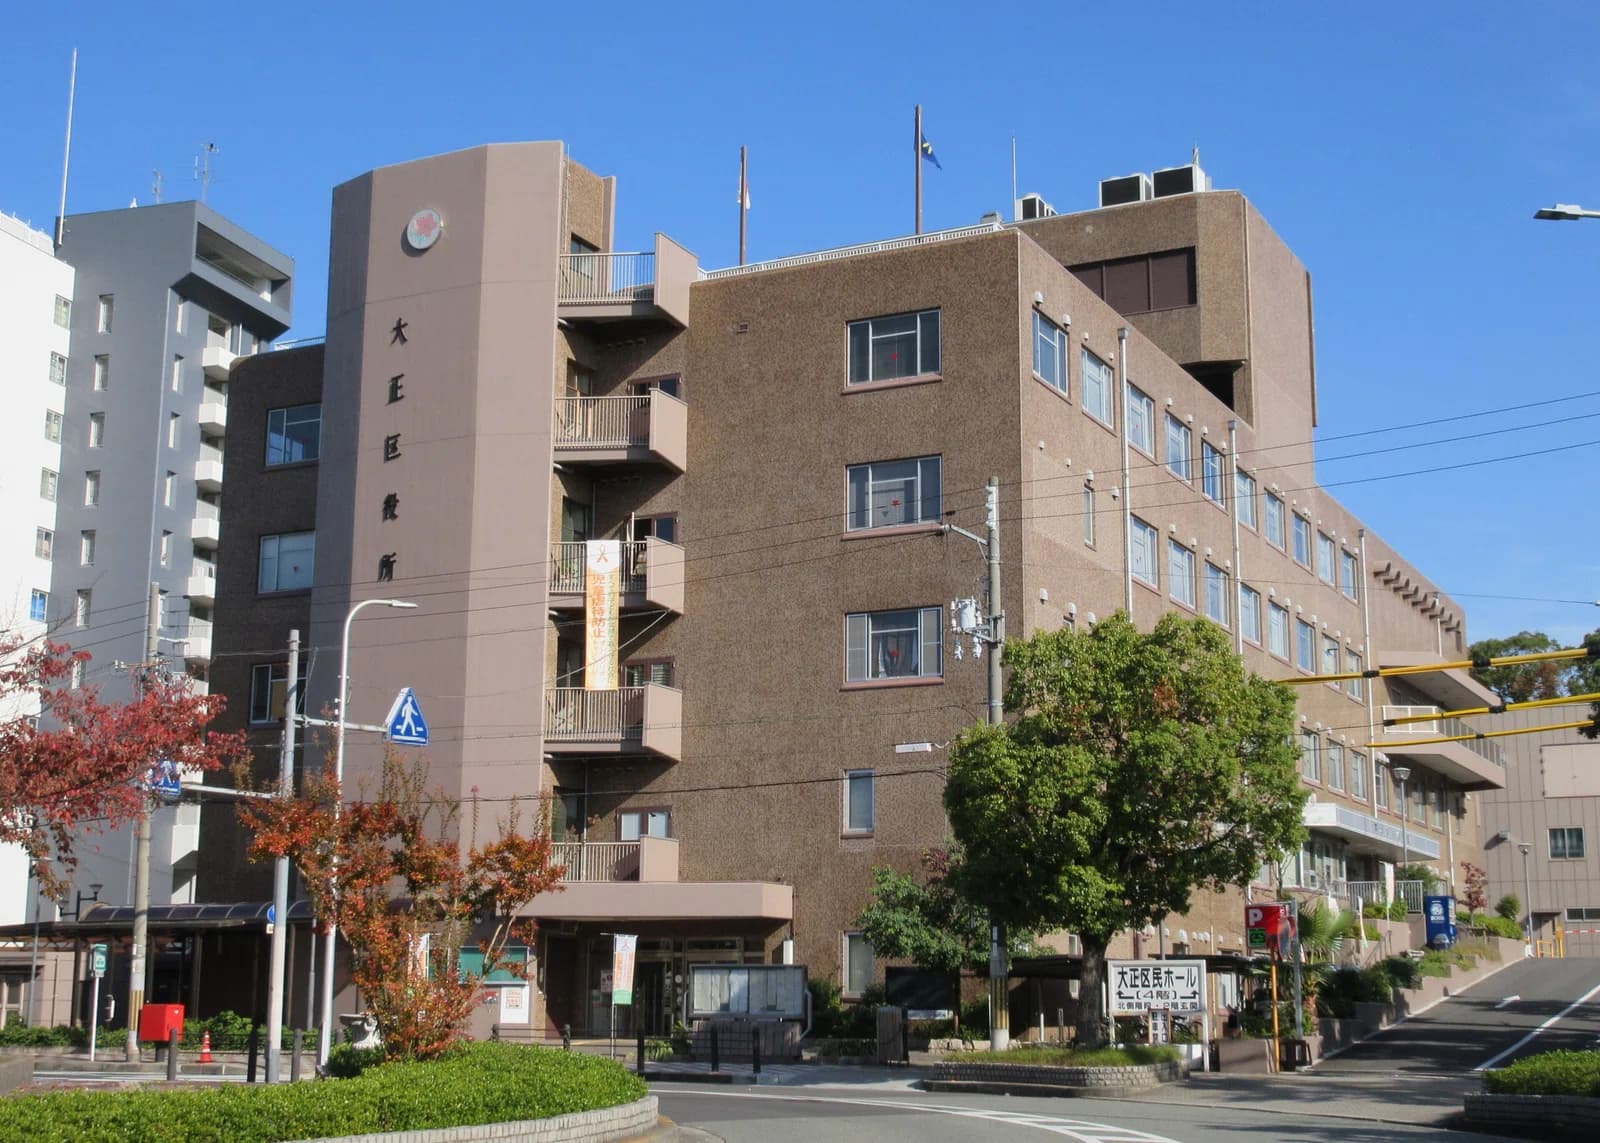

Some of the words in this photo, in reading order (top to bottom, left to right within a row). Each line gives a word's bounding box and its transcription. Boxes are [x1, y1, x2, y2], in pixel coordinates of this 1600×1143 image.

[378, 317, 408, 582] 大正区役所
[1248, 908, 1263, 926] P
[1117, 966, 1197, 989] 大正区民ホール
